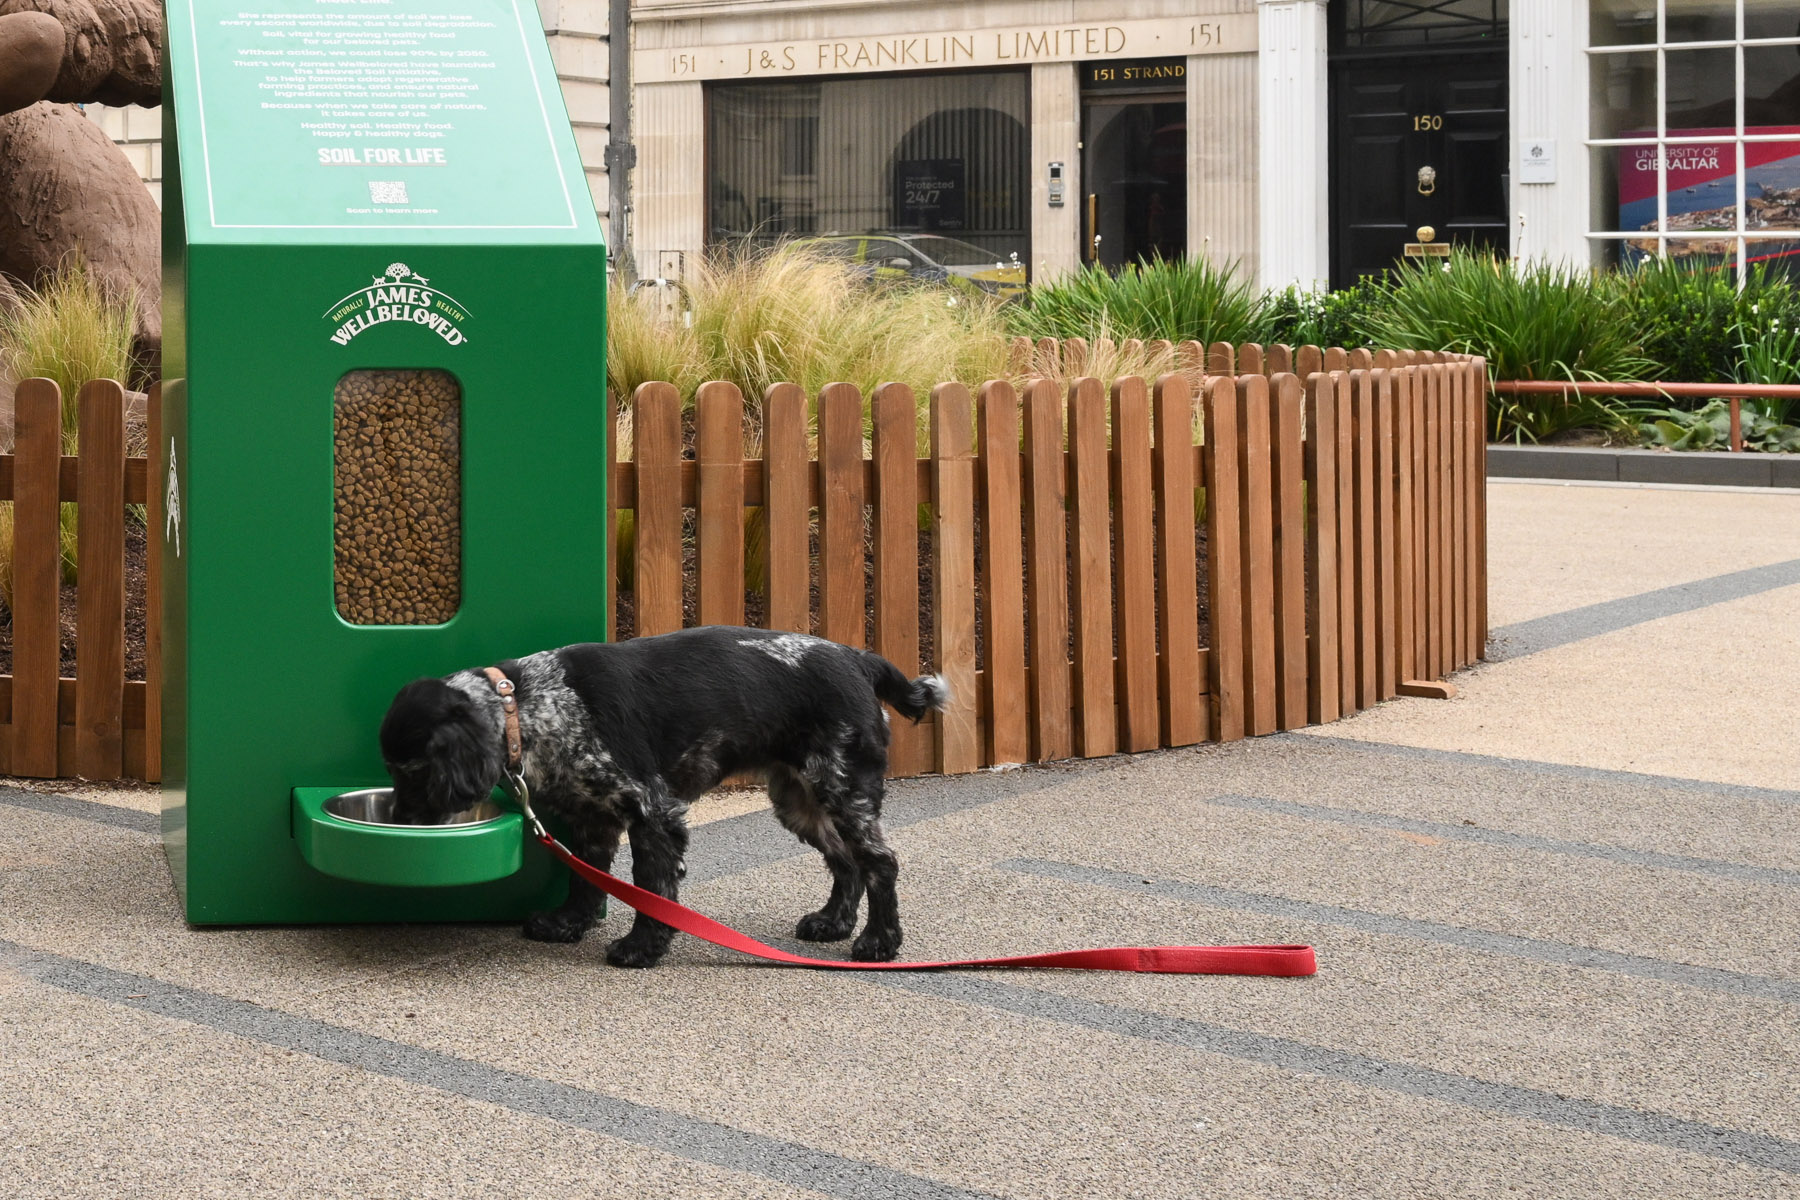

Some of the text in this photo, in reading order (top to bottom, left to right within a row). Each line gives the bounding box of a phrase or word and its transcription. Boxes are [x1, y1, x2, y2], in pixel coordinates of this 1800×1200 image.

[334, 31, 381, 39] growing
[384, 31, 427, 39] healthy
[671, 23, 1222, 75] 151 J&S FRANKLIN LIMITED 151
[1093, 65, 1185, 81] 151 STRAND
[300, 122, 347, 130] Healthy
[376, 122, 422, 130] Healthy
[1413, 115, 1442, 131] 150
[312, 130, 351, 138] Happy
[318, 148, 447, 164] SOIL FOR LIFE
[1635, 147, 1720, 158] UNIERSITY OF
[905, 180, 955, 190] Protected
[905, 190, 941, 204] 24/7
[366, 286, 433, 309] JAMES
[331, 298, 364, 323] NATURALLY
[435, 300, 465, 323] HEALTHY
[330, 304, 463, 346] WELLBELOVED
